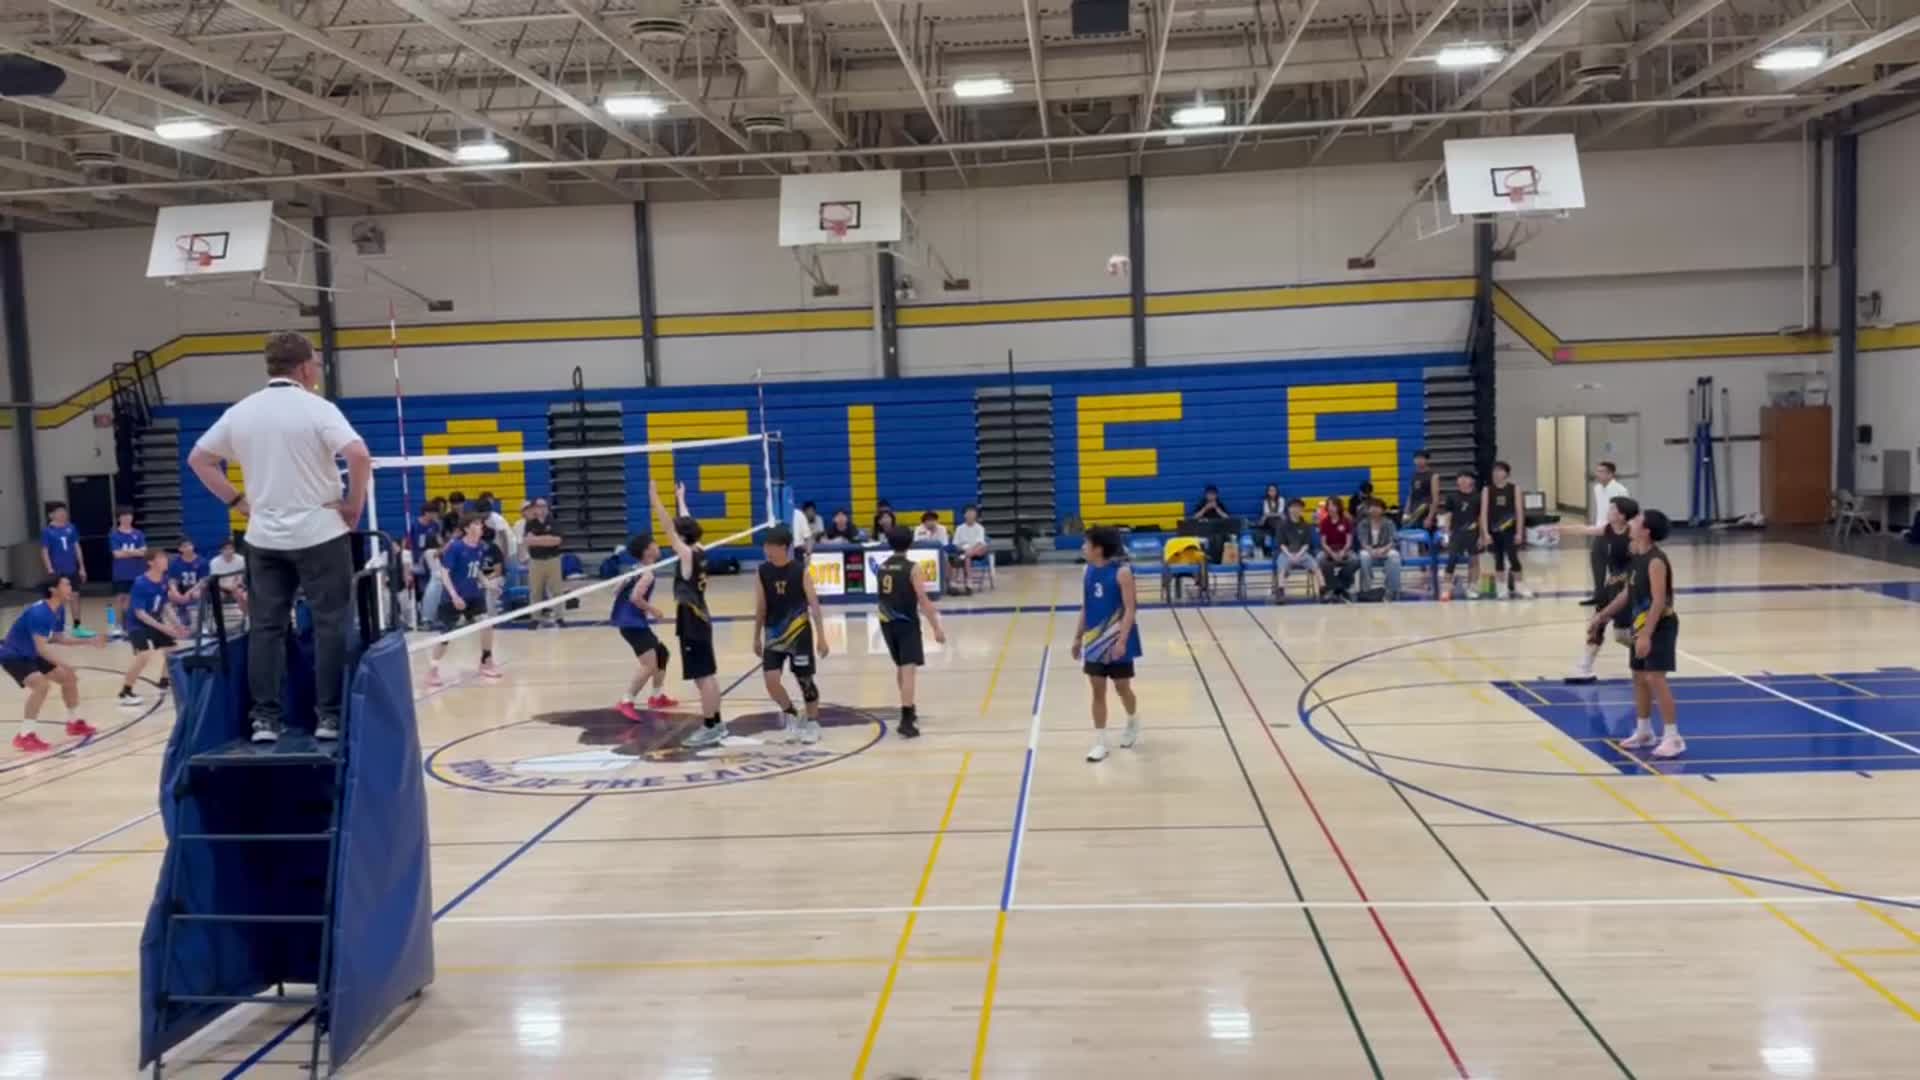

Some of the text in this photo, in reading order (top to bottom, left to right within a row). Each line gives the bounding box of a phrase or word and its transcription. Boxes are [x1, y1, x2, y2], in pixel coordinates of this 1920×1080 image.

[228, 383, 1399, 547] AGLES
[774, 580, 787, 594] 17
[882, 574, 893, 593] 9
[1094, 582, 1104, 598] 3
